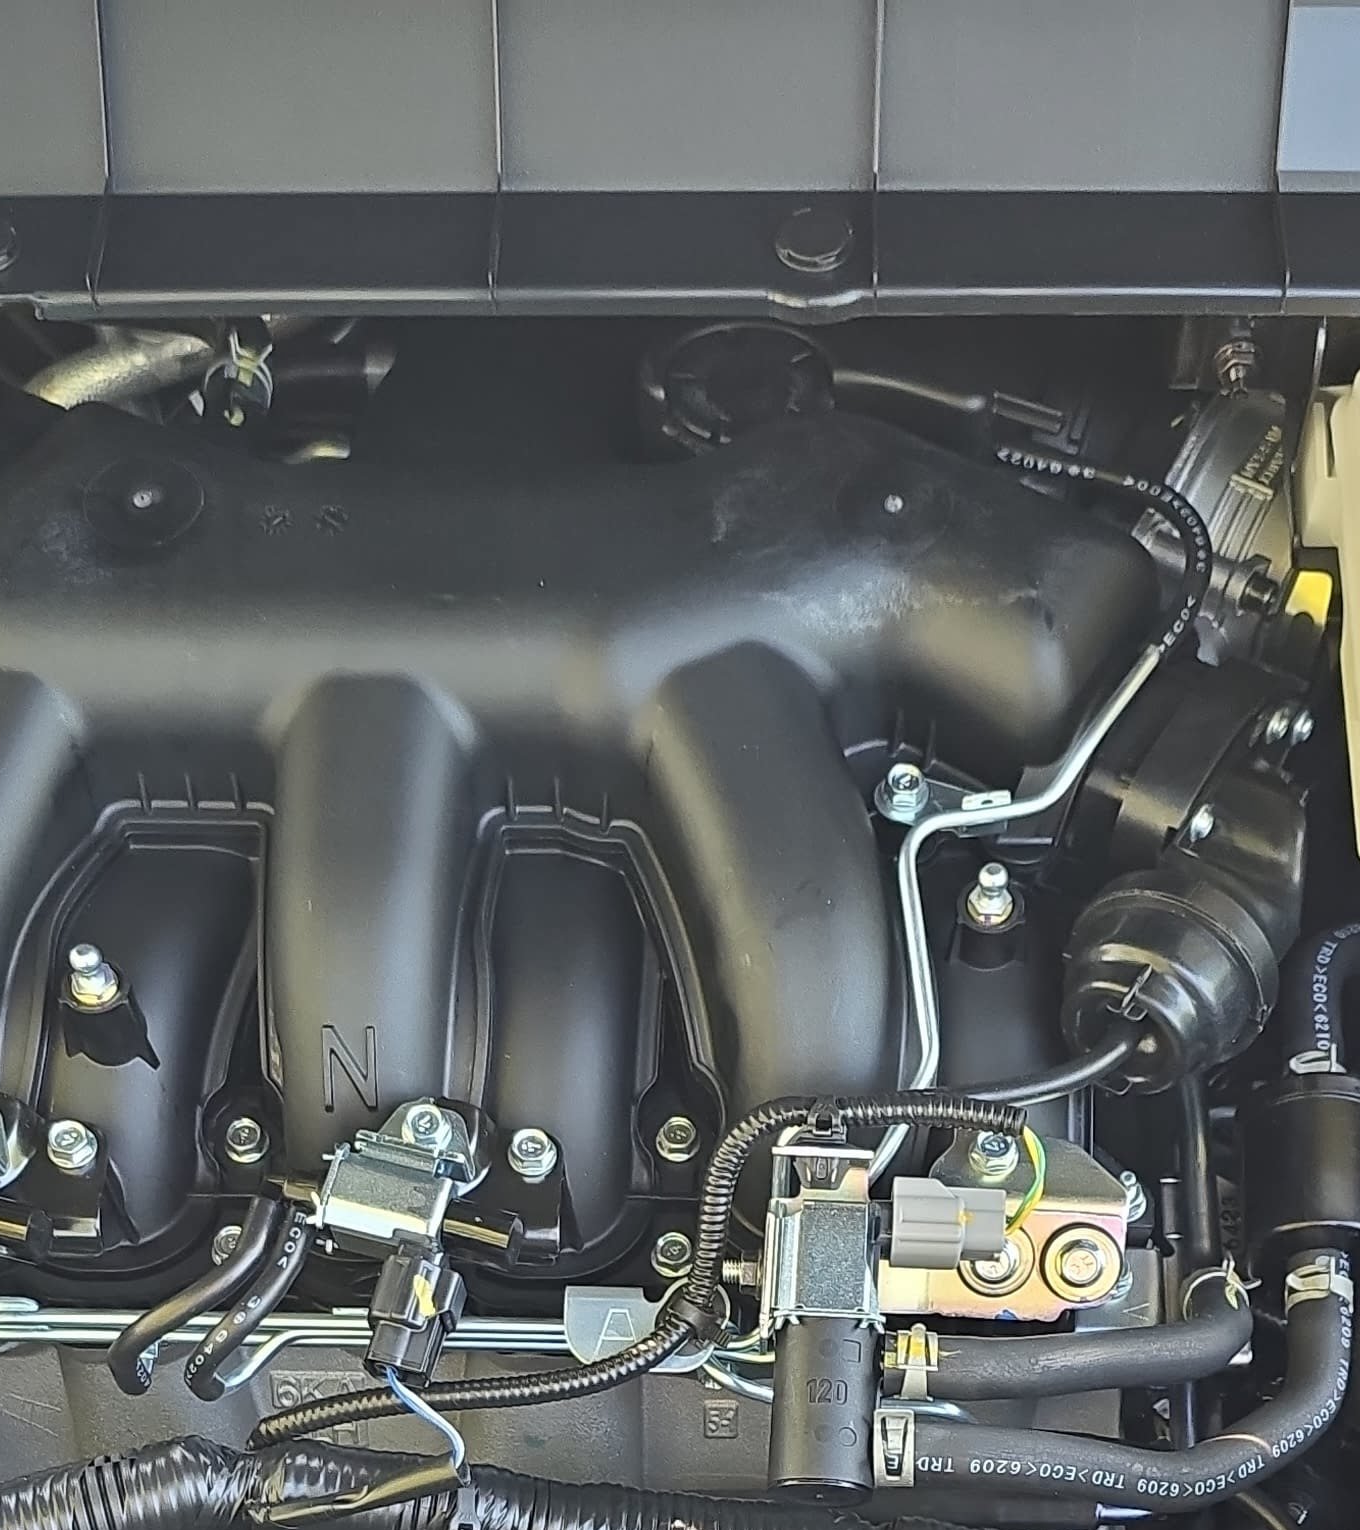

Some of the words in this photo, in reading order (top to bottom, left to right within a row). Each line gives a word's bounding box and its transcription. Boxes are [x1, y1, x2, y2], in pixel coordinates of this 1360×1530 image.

[321, 1024, 379, 1113] N
[806, 1378, 848, 1406] 120
[969, 1457, 1126, 1491] TRD>ECO<6209
[1136, 1455, 1267, 1498] TRD>ECO<6209
